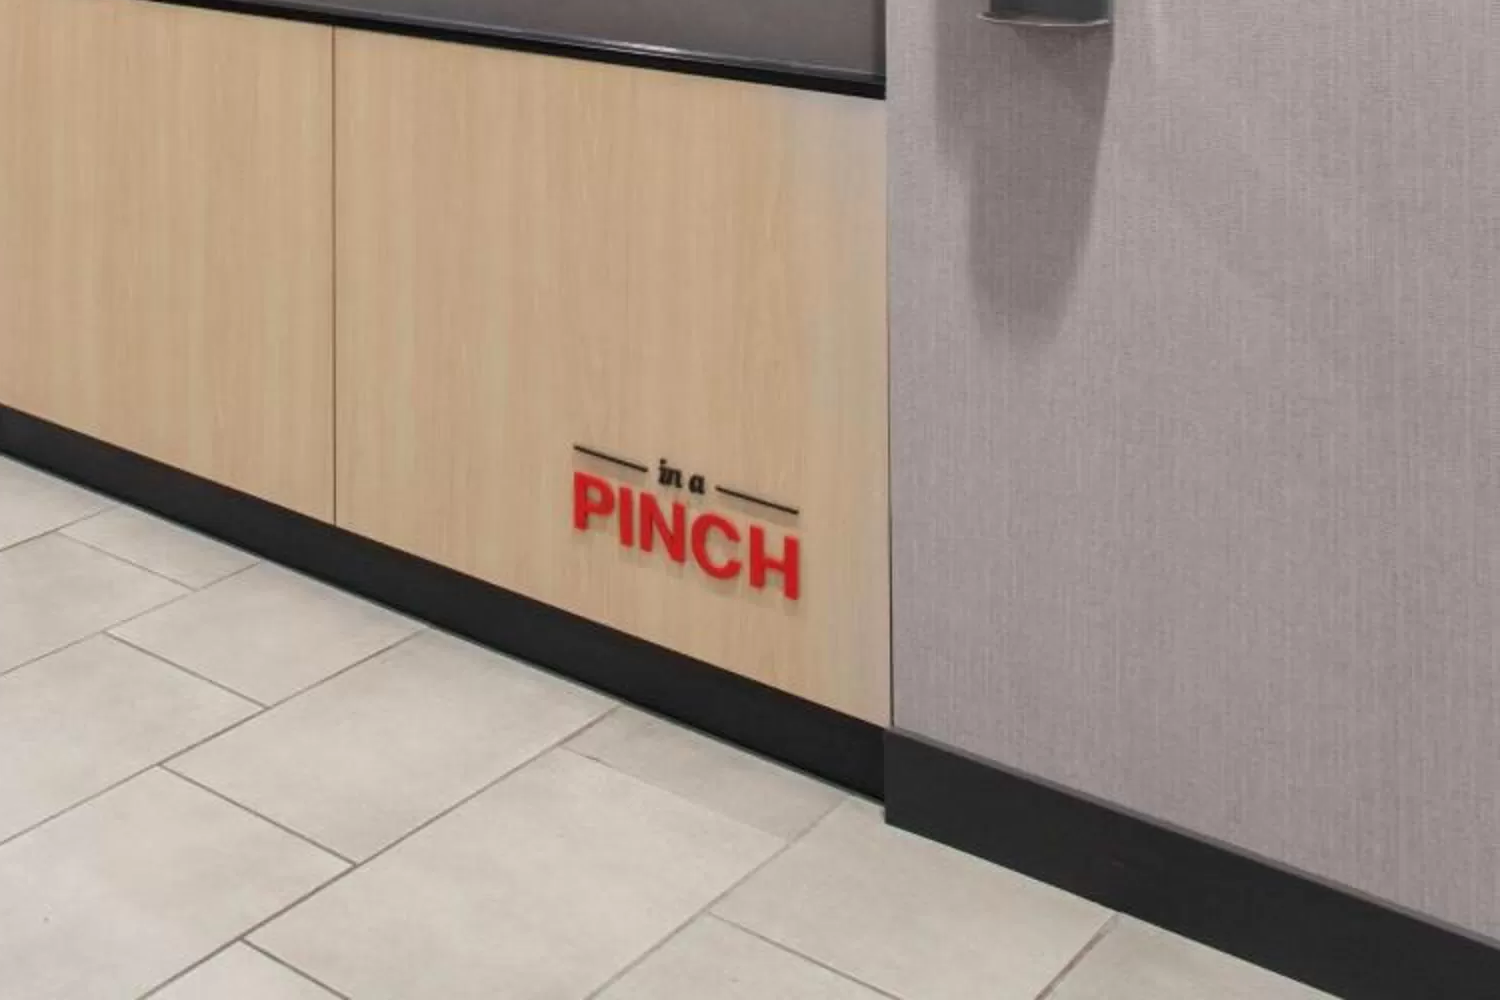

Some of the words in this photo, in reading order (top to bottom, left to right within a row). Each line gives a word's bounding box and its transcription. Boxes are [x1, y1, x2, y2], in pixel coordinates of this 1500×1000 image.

[657, 458, 683, 489] in
[688, 473, 706, 495] a
[573, 470, 800, 601] PINCH
